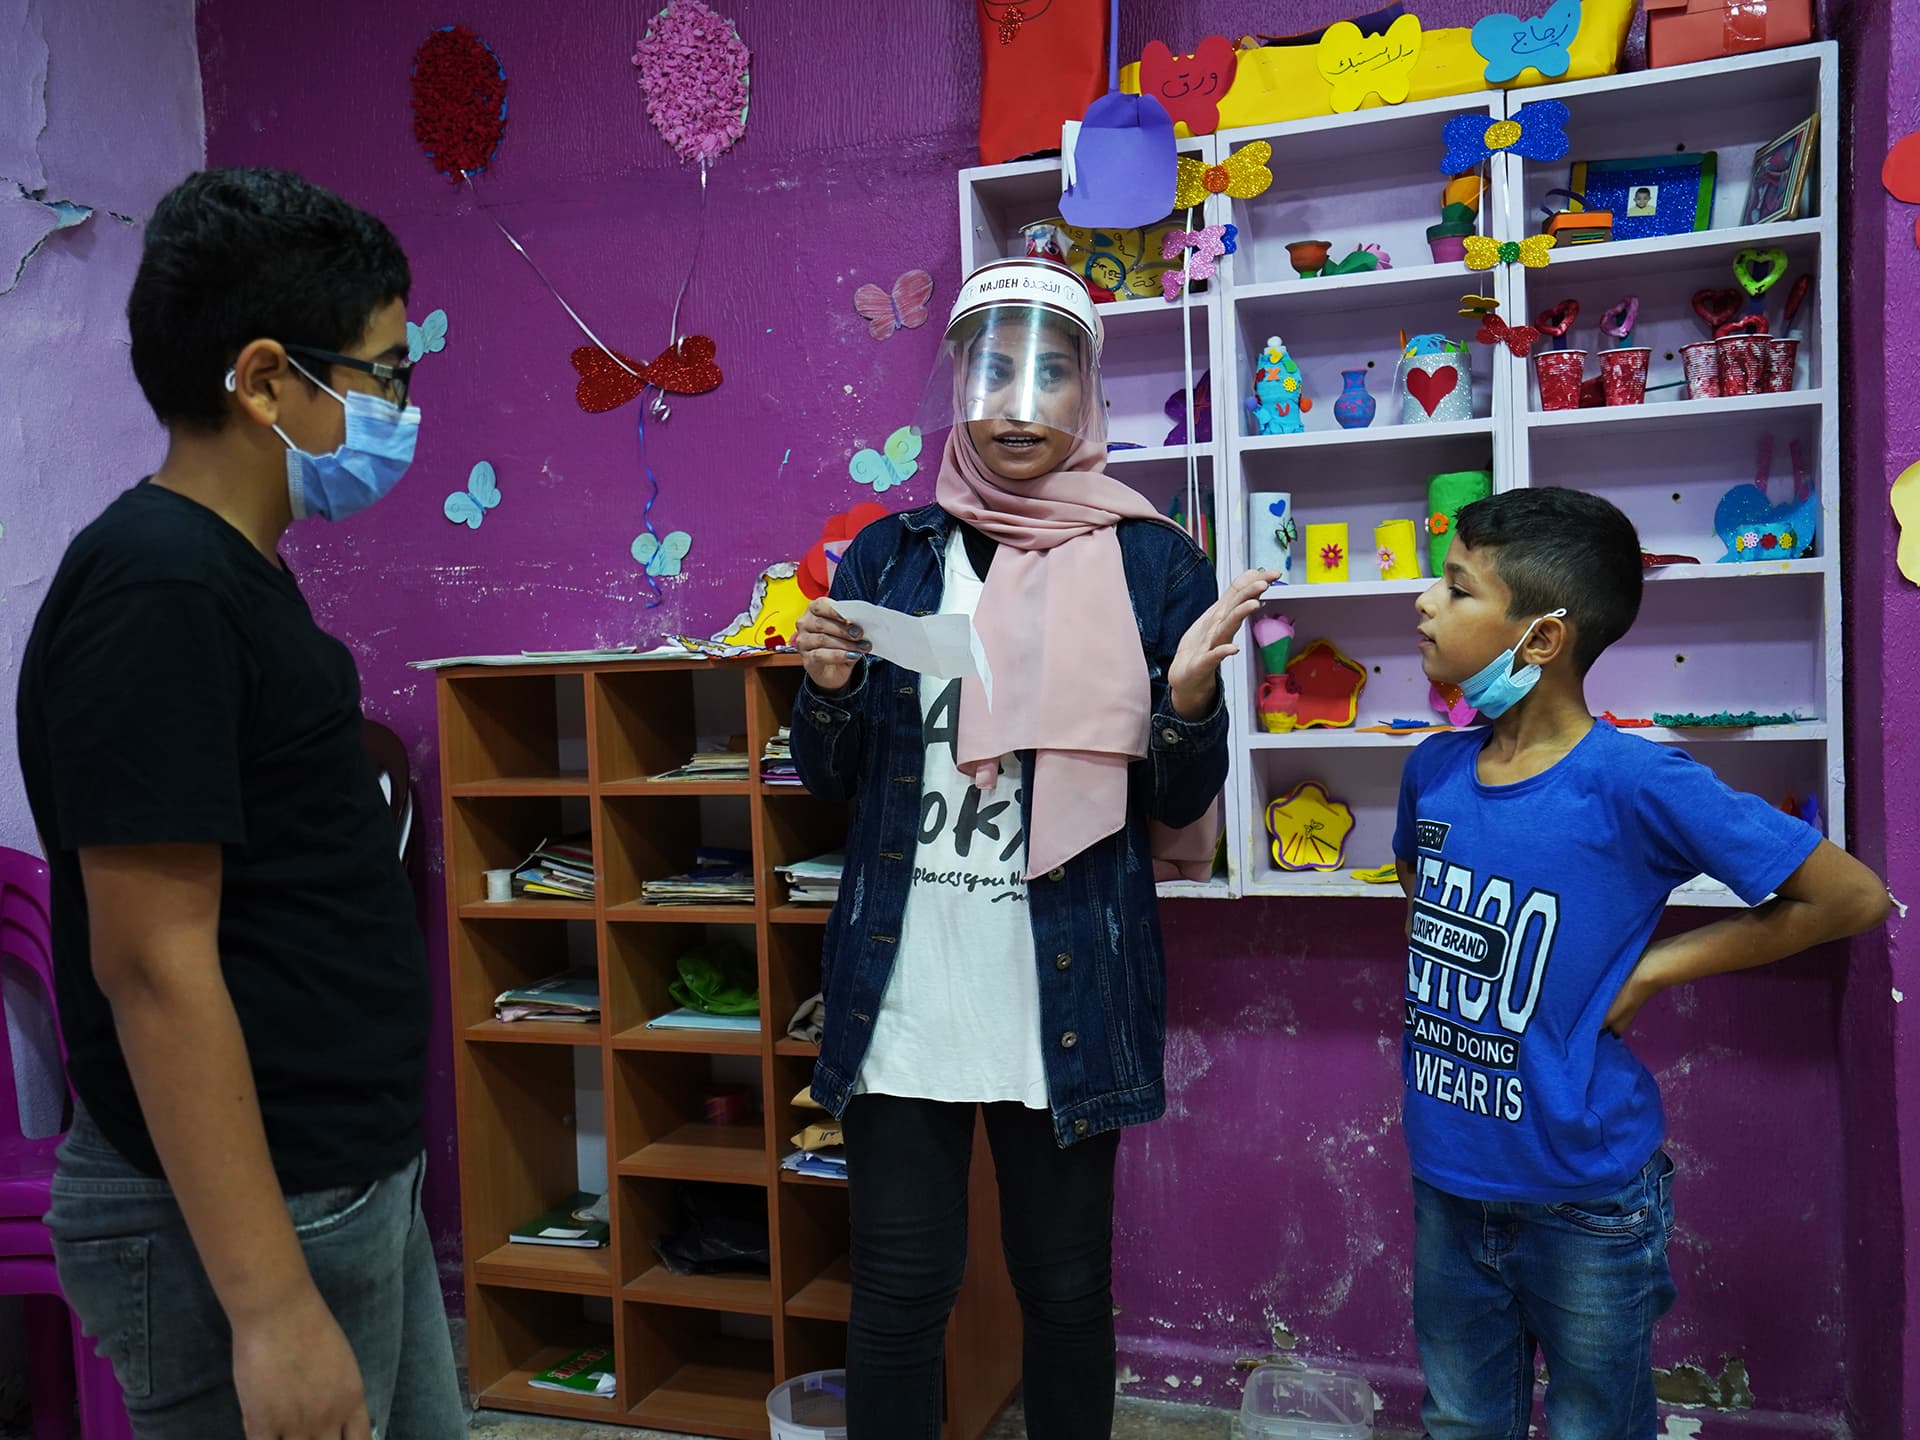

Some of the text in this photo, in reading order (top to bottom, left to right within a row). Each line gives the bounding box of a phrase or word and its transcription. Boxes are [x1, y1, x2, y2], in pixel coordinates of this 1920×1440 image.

[1511, 12, 1570, 54] زجاج
[1161, 72, 1218, 99] ورق
[979, 278, 1019, 294] NAJDEH
[1412, 916, 1486, 960] UXURY BRAND
[1415, 1018, 1451, 1046] AND
[1457, 1030, 1514, 1065] DOING
[1415, 1050, 1523, 1122] WEAR IS
